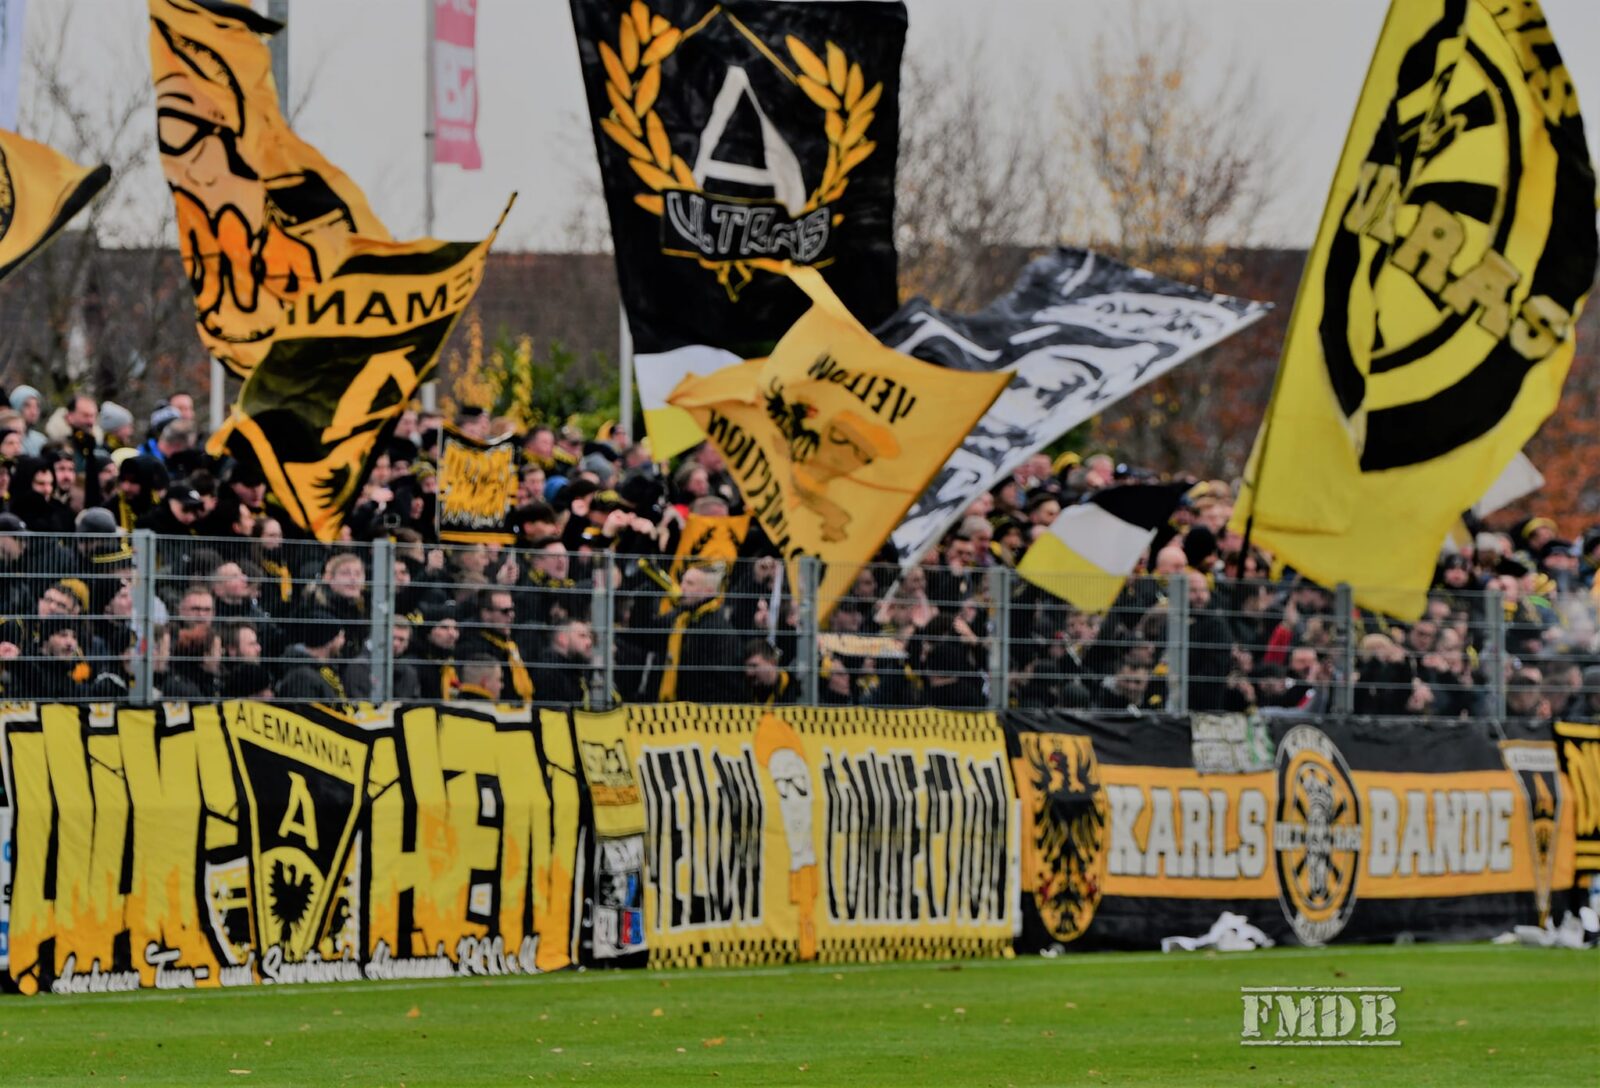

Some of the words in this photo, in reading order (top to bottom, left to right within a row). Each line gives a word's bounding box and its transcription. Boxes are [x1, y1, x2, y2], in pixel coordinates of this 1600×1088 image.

[694, 65, 805, 218] A
[666, 190, 830, 263] ULTRAS
[236, 702, 354, 773] ALEMANNIA
[278, 770, 319, 850] A
[1107, 784, 1267, 879] KARLS
[1368, 786, 1514, 878] BANDE
